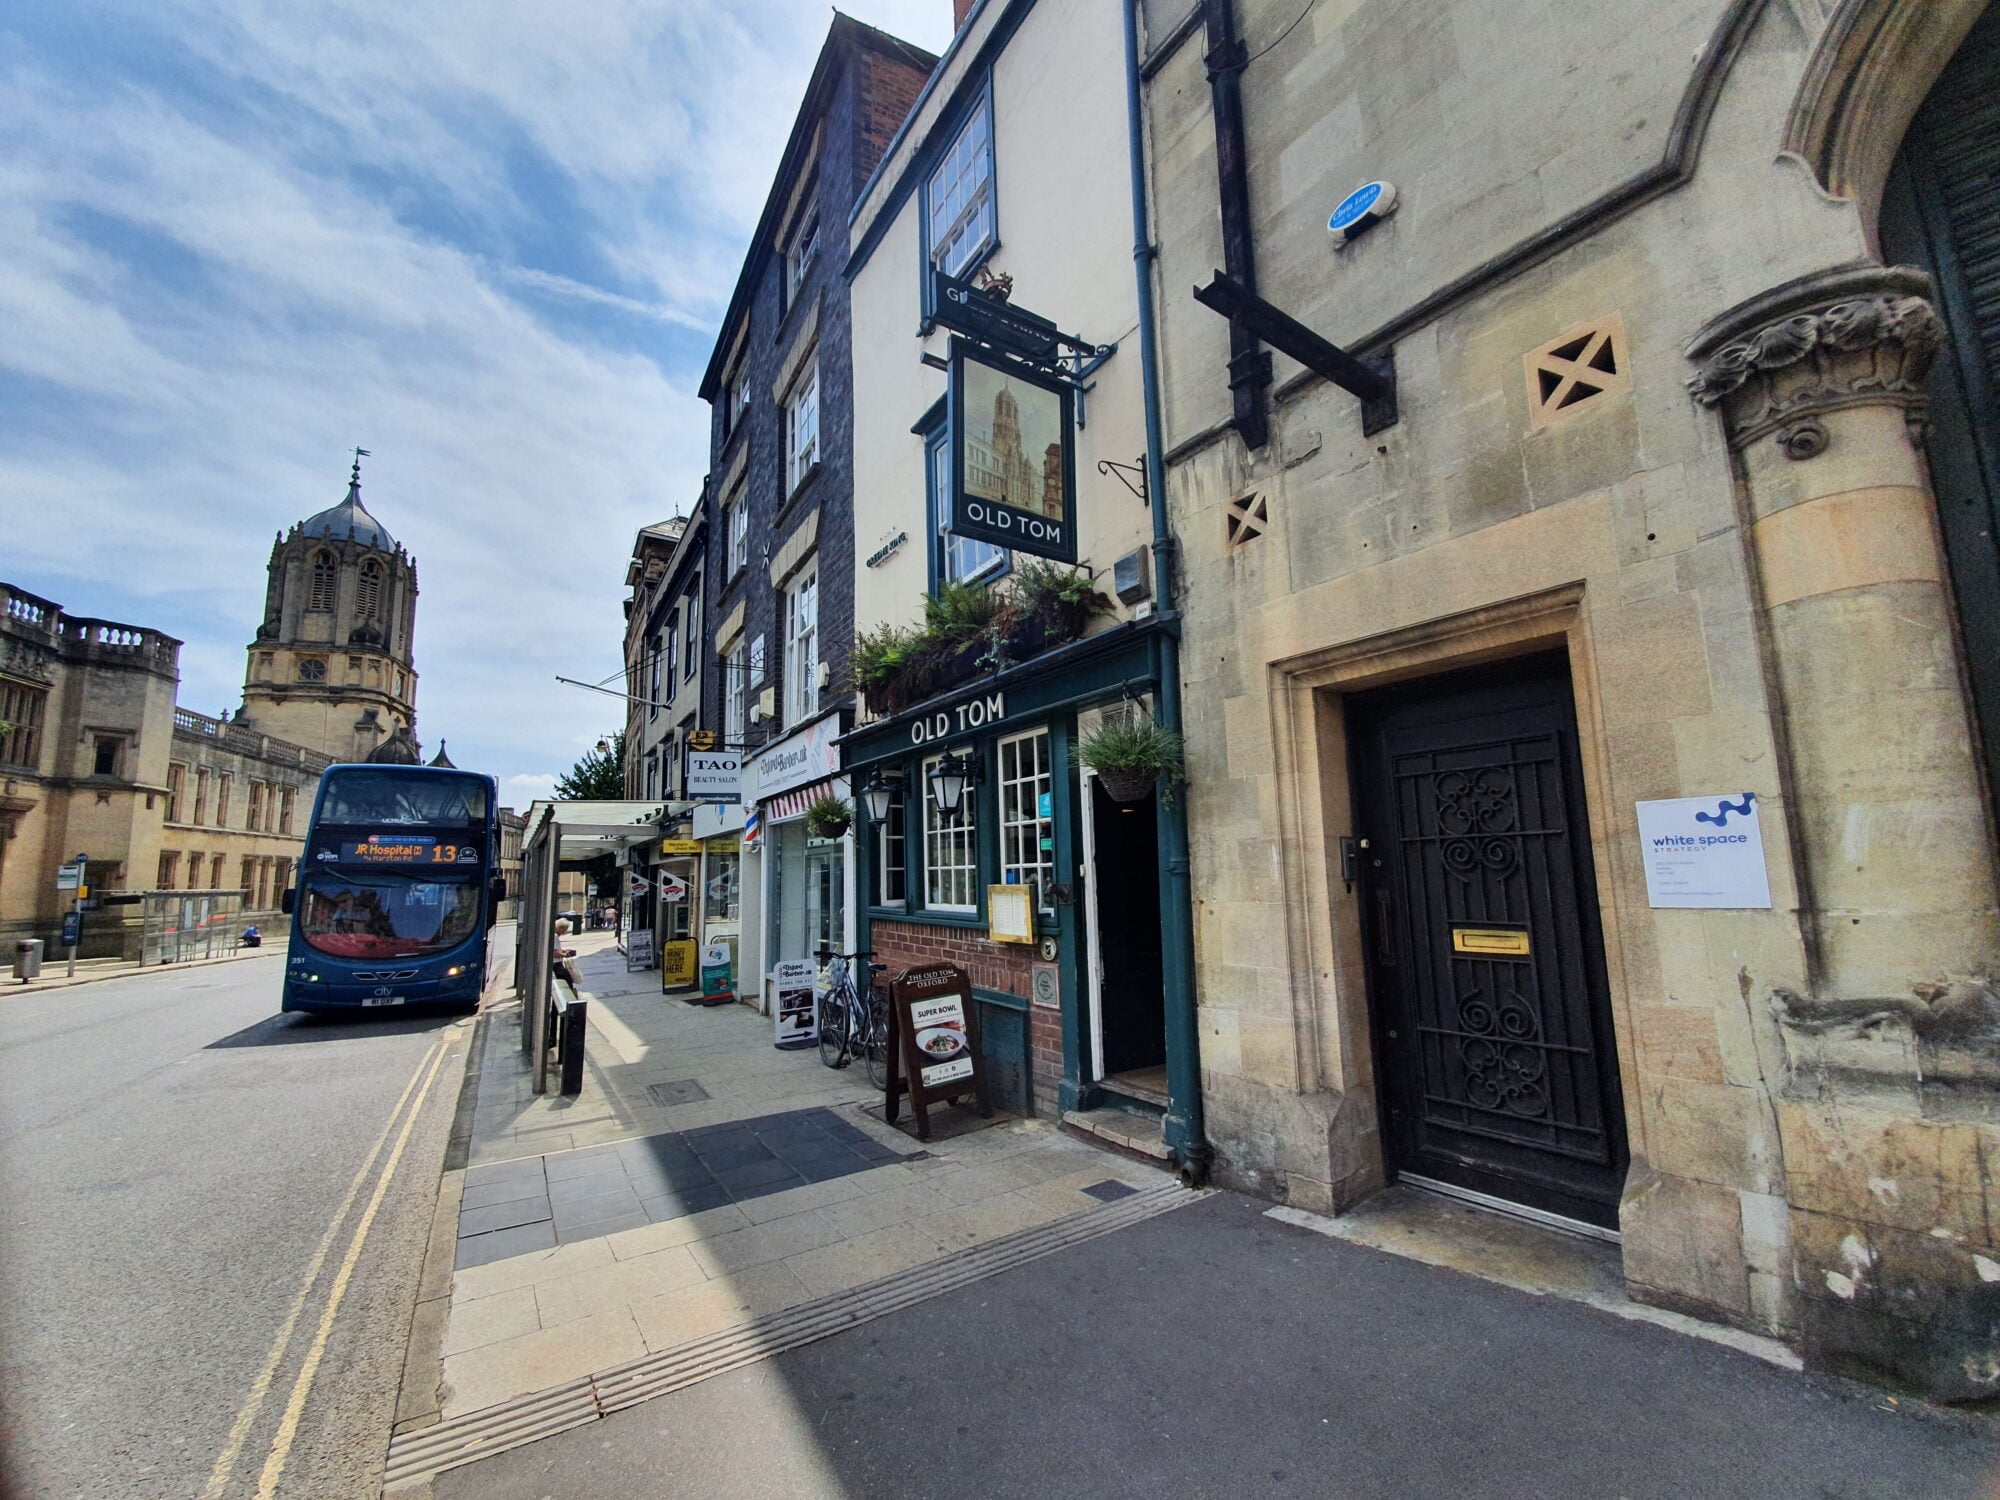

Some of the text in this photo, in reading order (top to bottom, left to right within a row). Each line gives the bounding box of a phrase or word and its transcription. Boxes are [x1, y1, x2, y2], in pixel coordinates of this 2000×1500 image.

[967, 502, 1061, 544] OLD TOM
[911, 692, 1005, 745] OLD TOM
[694, 759, 737, 770] TAO
[1653, 834, 1747, 846] white space
[355, 843, 368, 855] JR
[369, 844, 413, 856] Hospital
[432, 844, 457, 863] 13
[909, 974, 923, 982] THE
[923, 971, 938, 979] OLD
[917, 978, 948, 988] OXFORD
[917, 1007, 938, 1018] SUPER
[939, 1005, 957, 1014] BOWL
